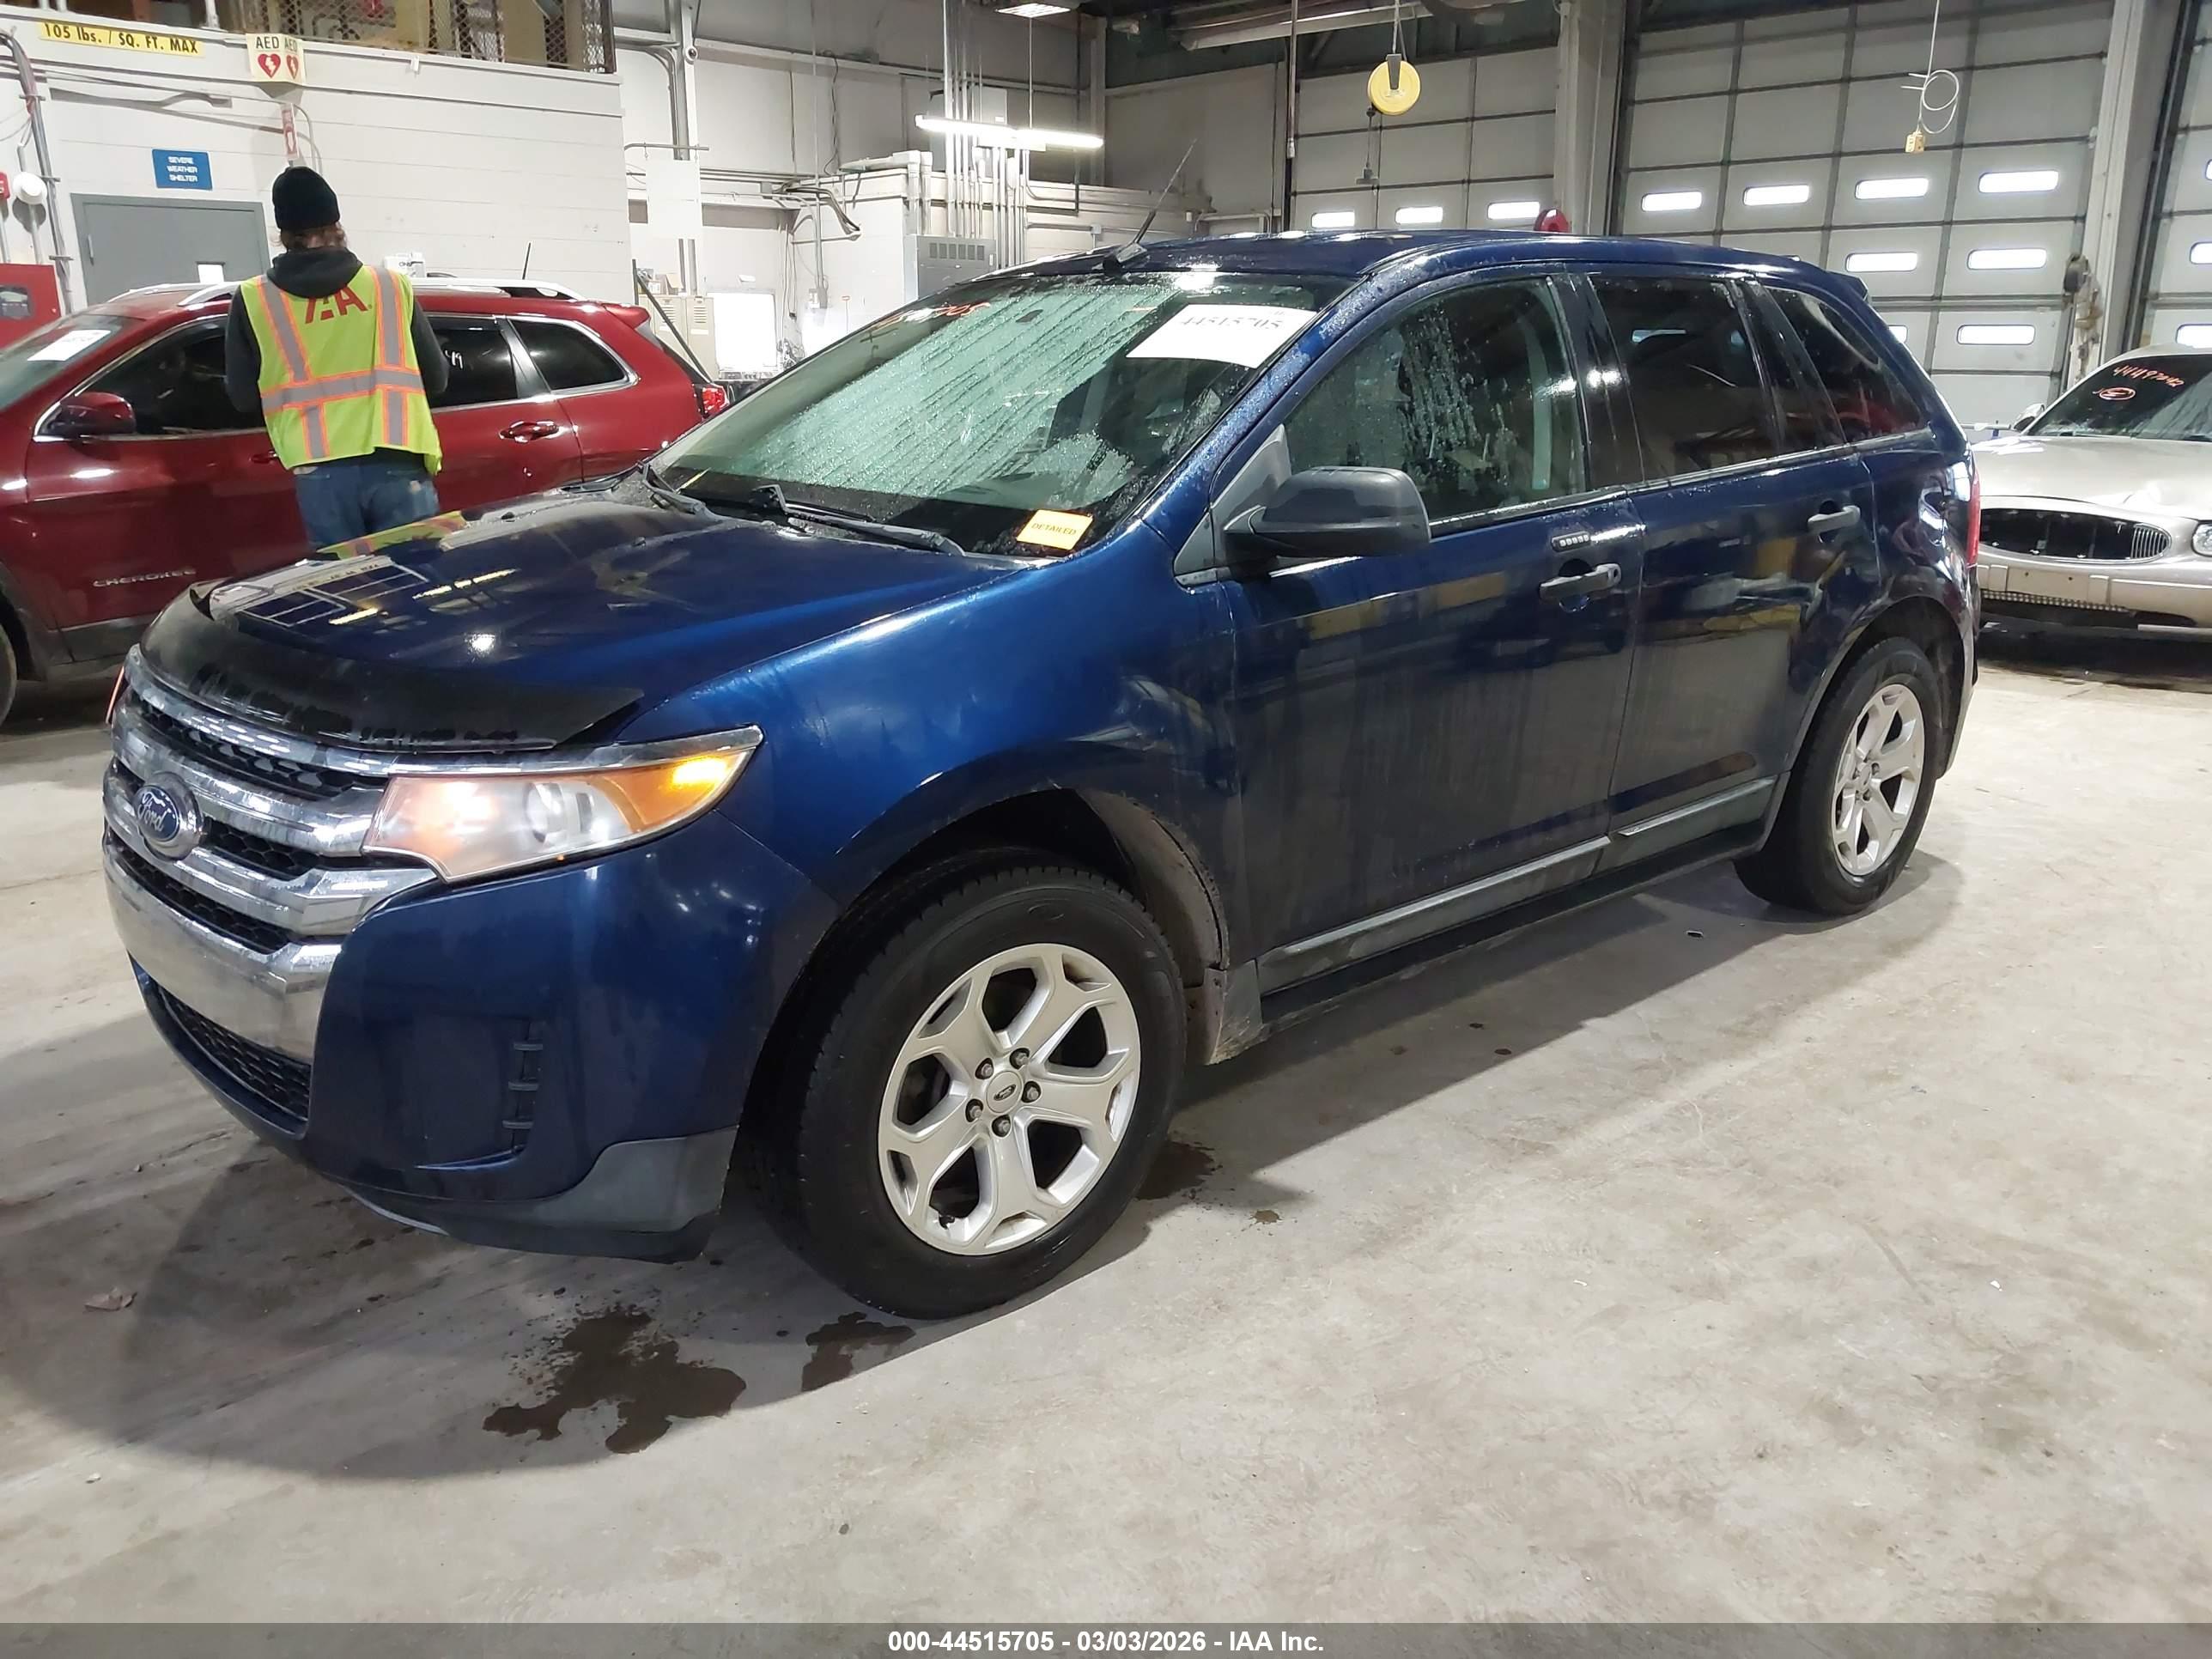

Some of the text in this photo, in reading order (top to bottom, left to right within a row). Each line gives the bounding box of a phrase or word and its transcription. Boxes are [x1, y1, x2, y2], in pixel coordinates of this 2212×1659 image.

[45, 23, 70, 39] 105
[76, 25, 102, 43] lbs.
[118, 32, 140, 47] SQ.
[146, 36, 164, 50] FT.
[170, 38, 198, 53] MAX
[256, 36, 280, 49] AED
[284, 37, 298, 52] AED
[166, 165, 198, 173] WEATHER
[168, 173, 198, 182] SHELTER
[1031, 522, 1078, 536] DETAILED
[93, 568, 197, 587] CHEROKEE
[138, 791, 173, 832] Ford
